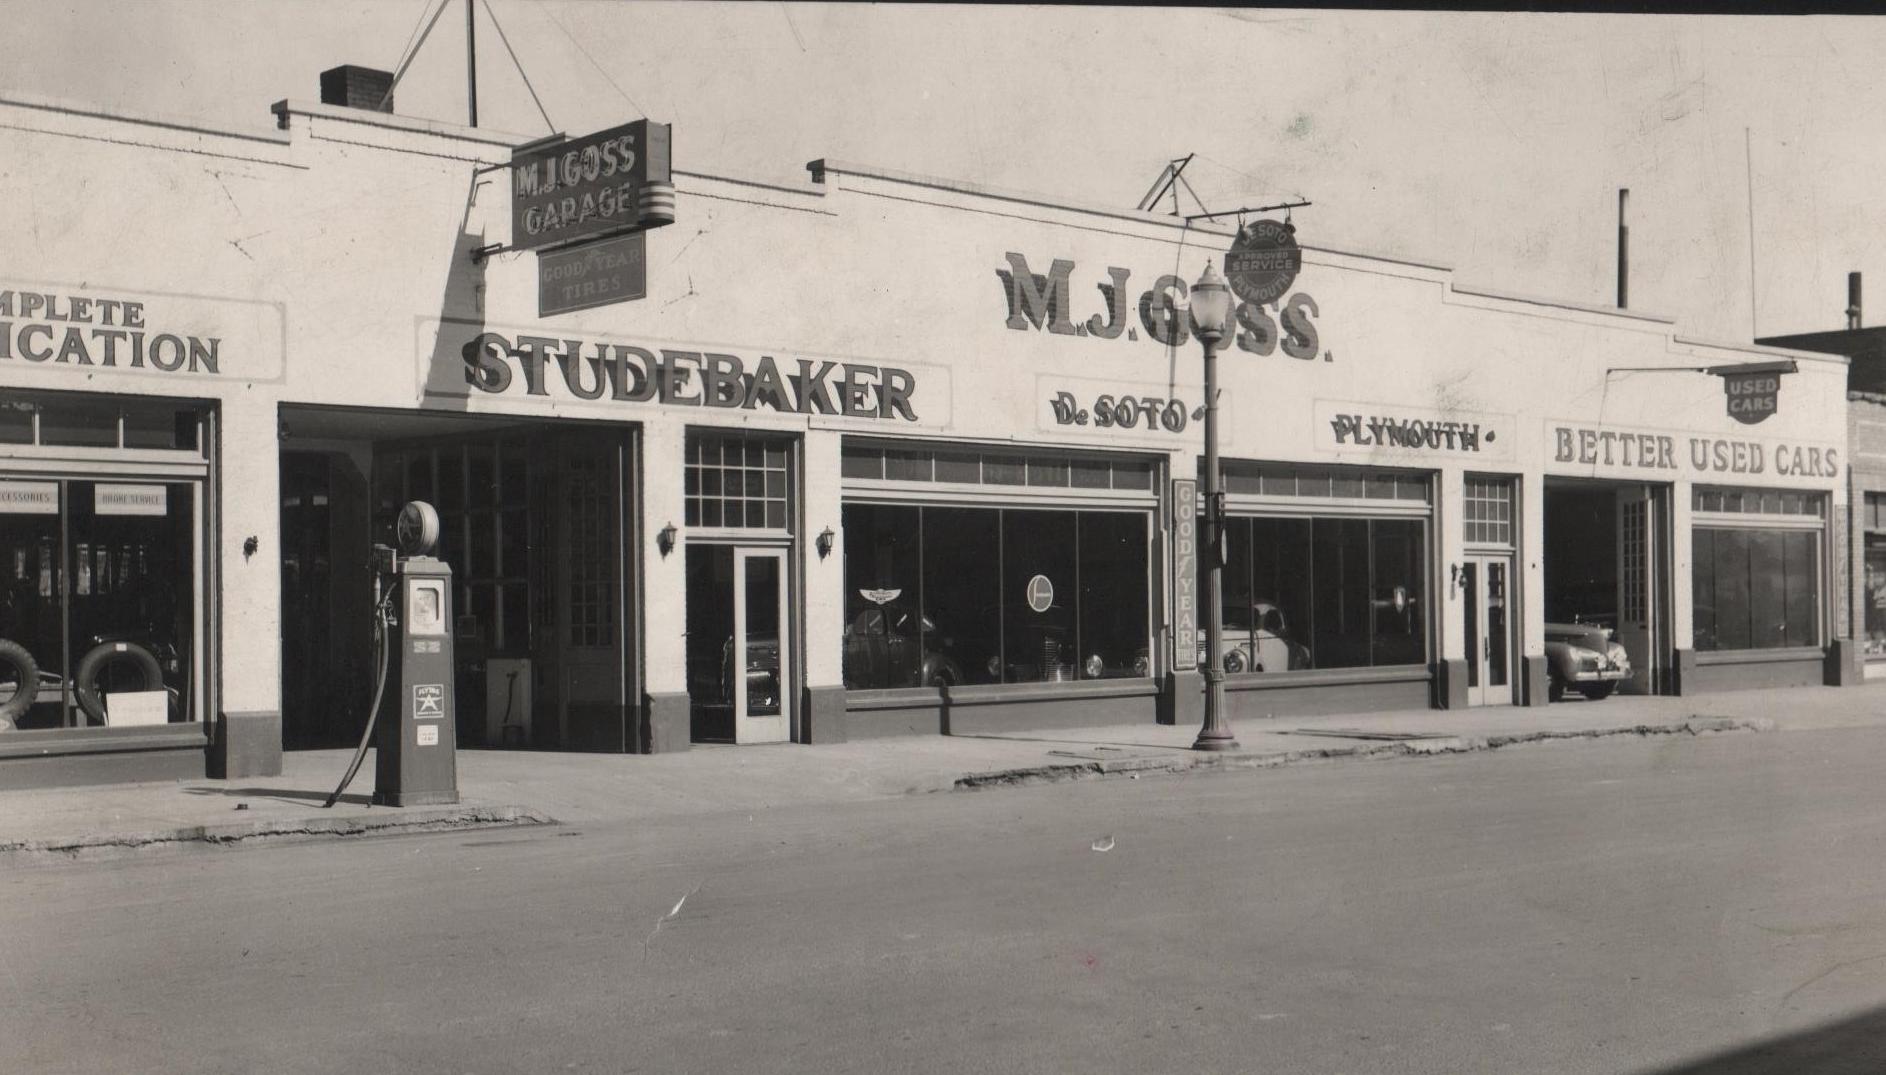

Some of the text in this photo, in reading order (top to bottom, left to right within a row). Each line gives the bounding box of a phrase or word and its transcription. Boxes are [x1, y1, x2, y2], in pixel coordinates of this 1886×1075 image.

[522, 182, 632, 236] GARAGE
[1231, 259, 1294, 272] SERVICE
[1238, 251, 1289, 260] APPROVED
[562, 273, 621, 302] TIRES
[462, 332, 919, 423] STUDEBAKER
[1730, 378, 1777, 395] USED
[1094, 394, 1188, 433] SOTO
[1730, 397, 1775, 412] CARS
[1330, 413, 1481, 452] PLYMOUTH
[1554, 427, 1839, 479] BETTER USED CARS
